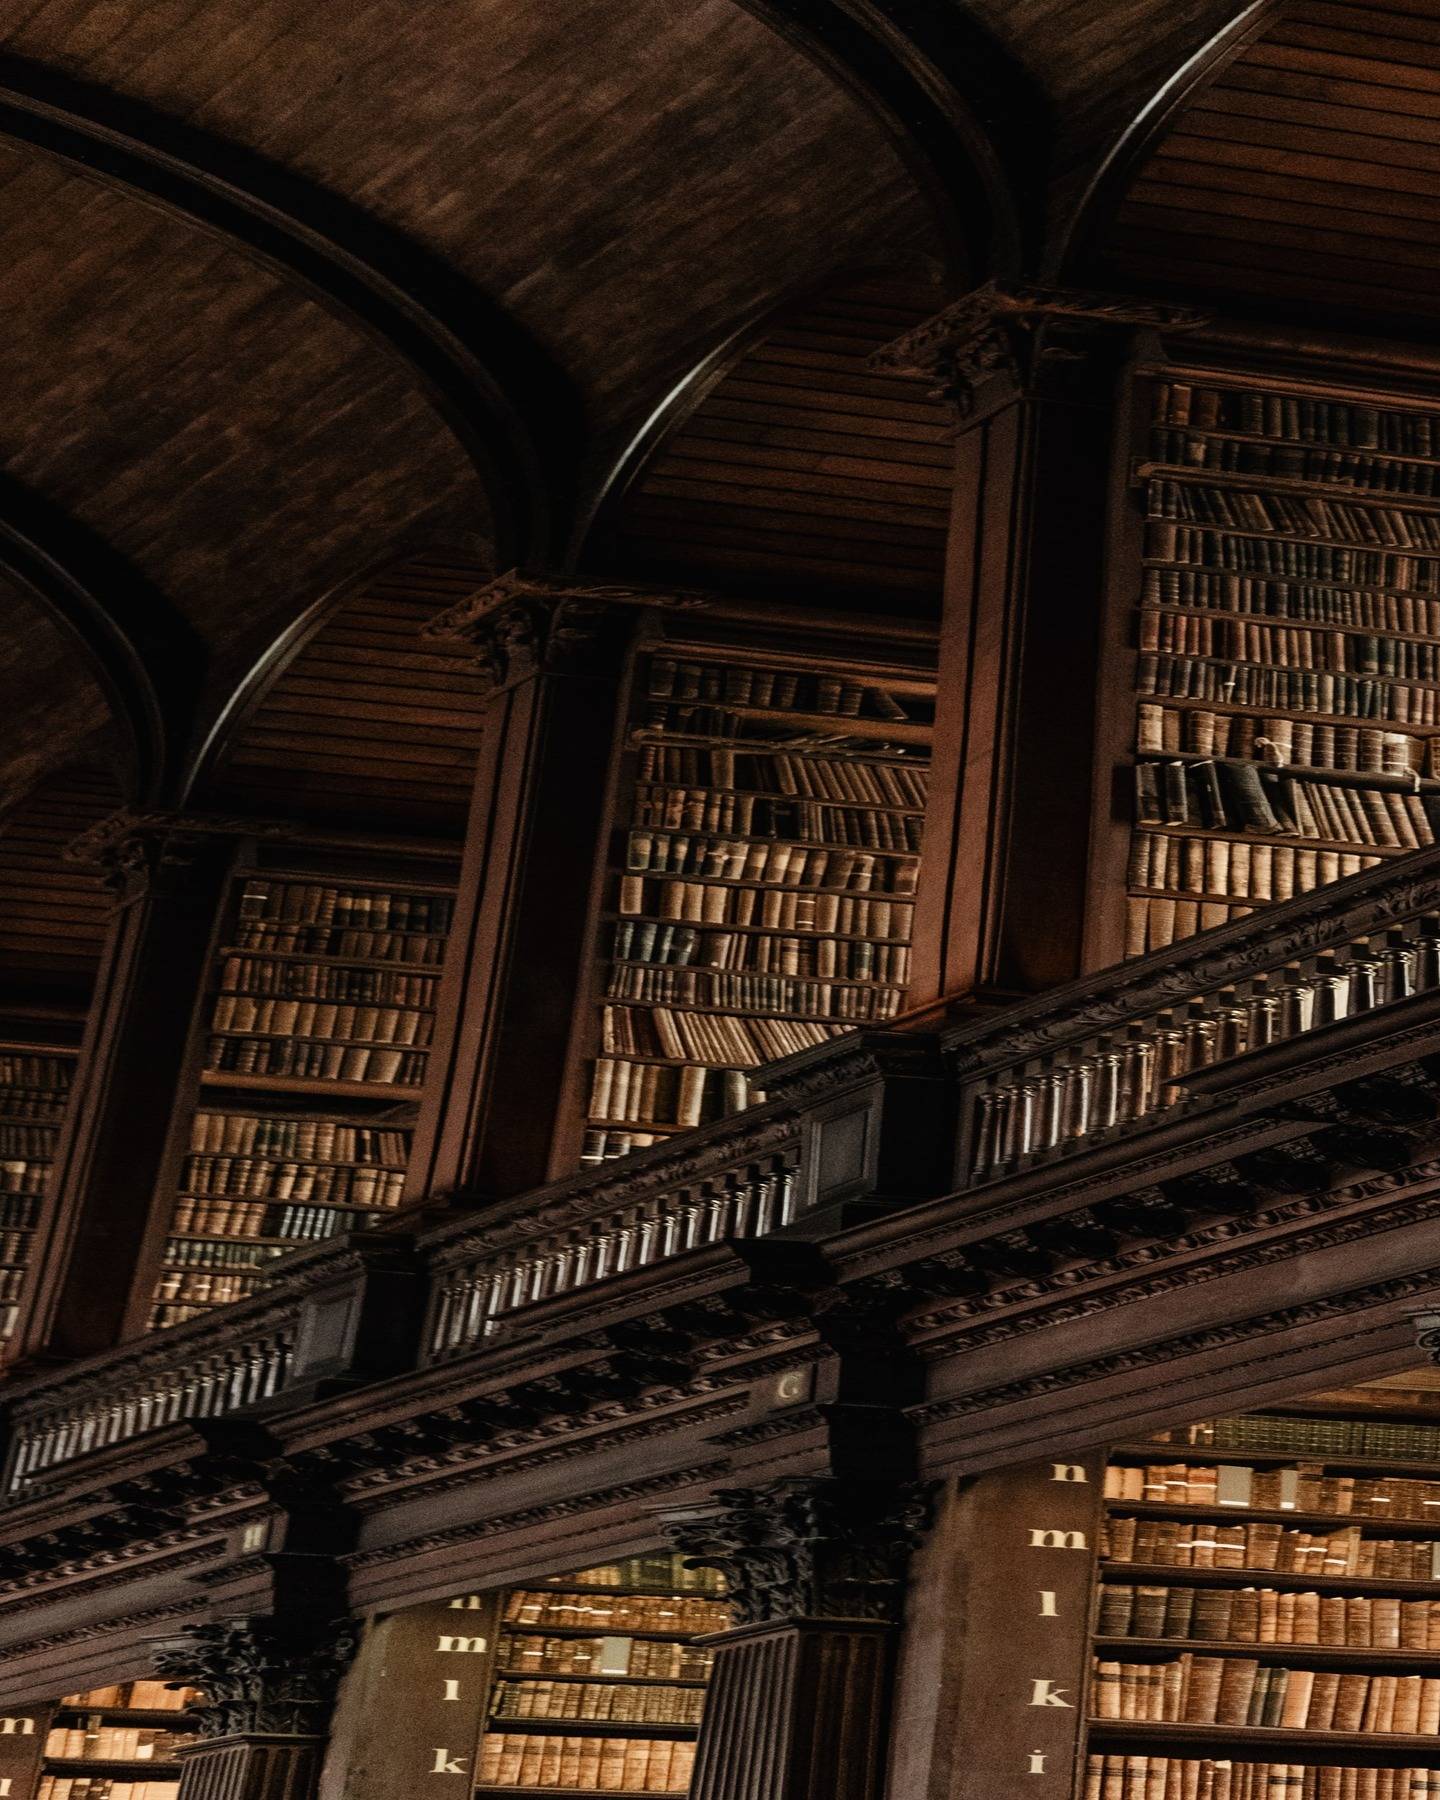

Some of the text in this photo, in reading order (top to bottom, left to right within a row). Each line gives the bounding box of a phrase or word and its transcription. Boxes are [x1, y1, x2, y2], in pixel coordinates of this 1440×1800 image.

[1050, 1463, 1089, 1483] n
[1028, 1528, 1089, 1550] m
[435, 1635, 487, 1653] m
[1027, 1678, 1075, 1708] k
[429, 1748, 468, 1774] k
[1027, 1749, 1048, 1774] i
